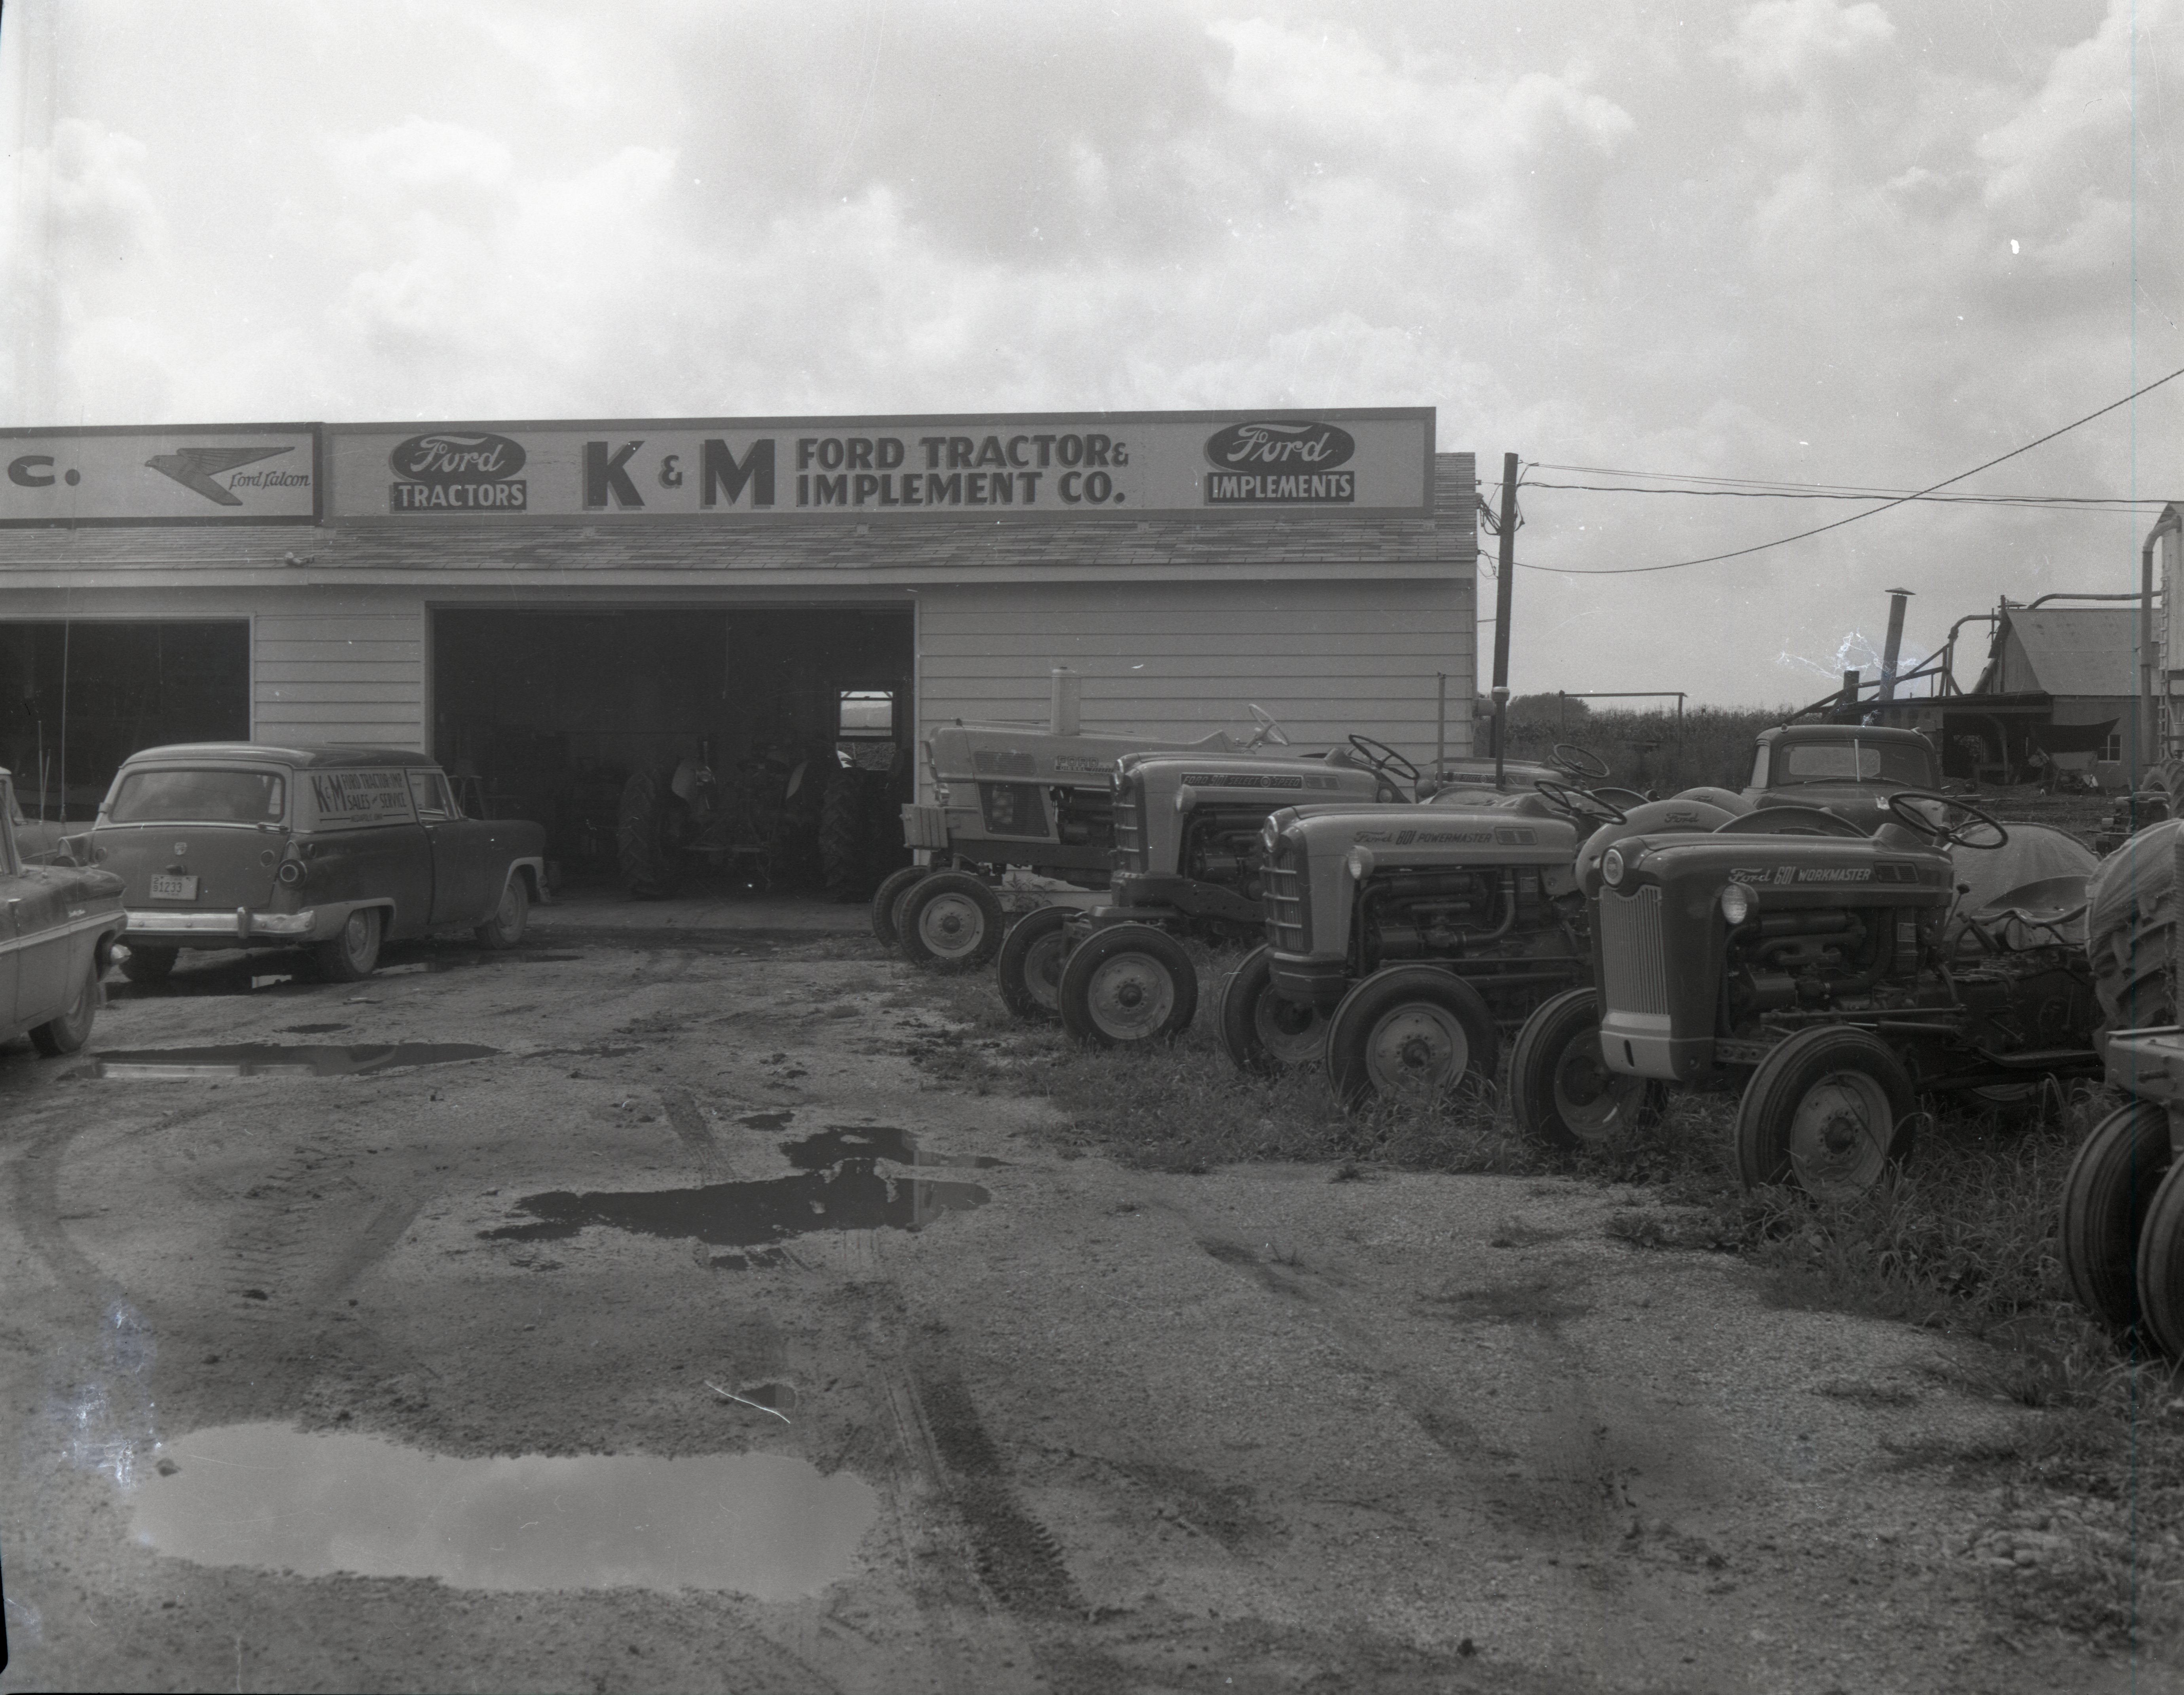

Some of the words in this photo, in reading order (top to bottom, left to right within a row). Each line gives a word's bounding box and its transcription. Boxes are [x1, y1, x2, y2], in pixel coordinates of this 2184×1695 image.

[797, 438, 904, 470] FORD
[919, 434, 1111, 468] TRACTOR
[1227, 424, 1332, 461] Ford
[410, 435, 505, 473] Ford
[229, 471, 263, 490] Ford
[262, 471, 311, 490] Falcon
[585, 440, 646, 508] K
[660, 454, 682, 488] &
[703, 439, 775, 507] M
[397, 484, 524, 508] TRACTORS
[796, 471, 1043, 507] IMPLEMENT
[1058, 471, 1125, 505] CO.
[1212, 474, 1351, 499] IMPLEMENTS
[1057, 755, 1098, 767] FORD
[341, 774, 361, 790] FORD
[1183, 776, 1208, 784] FORD
[1209, 774, 1228, 786] 901
[347, 793, 370, 810] SALES
[379, 792, 407, 809] SERVICE
[1665, 812, 1700, 823] Ford
[1354, 830, 1393, 843] Ford
[1395, 830, 1417, 845] 801
[1416, 832, 1493, 843] POWERMASTER
[1728, 867, 1771, 883] Ford
[1773, 866, 1796, 885] 601
[1797, 868, 1872, 881] WORKMASTER
[159, 881, 183, 893] 1233
